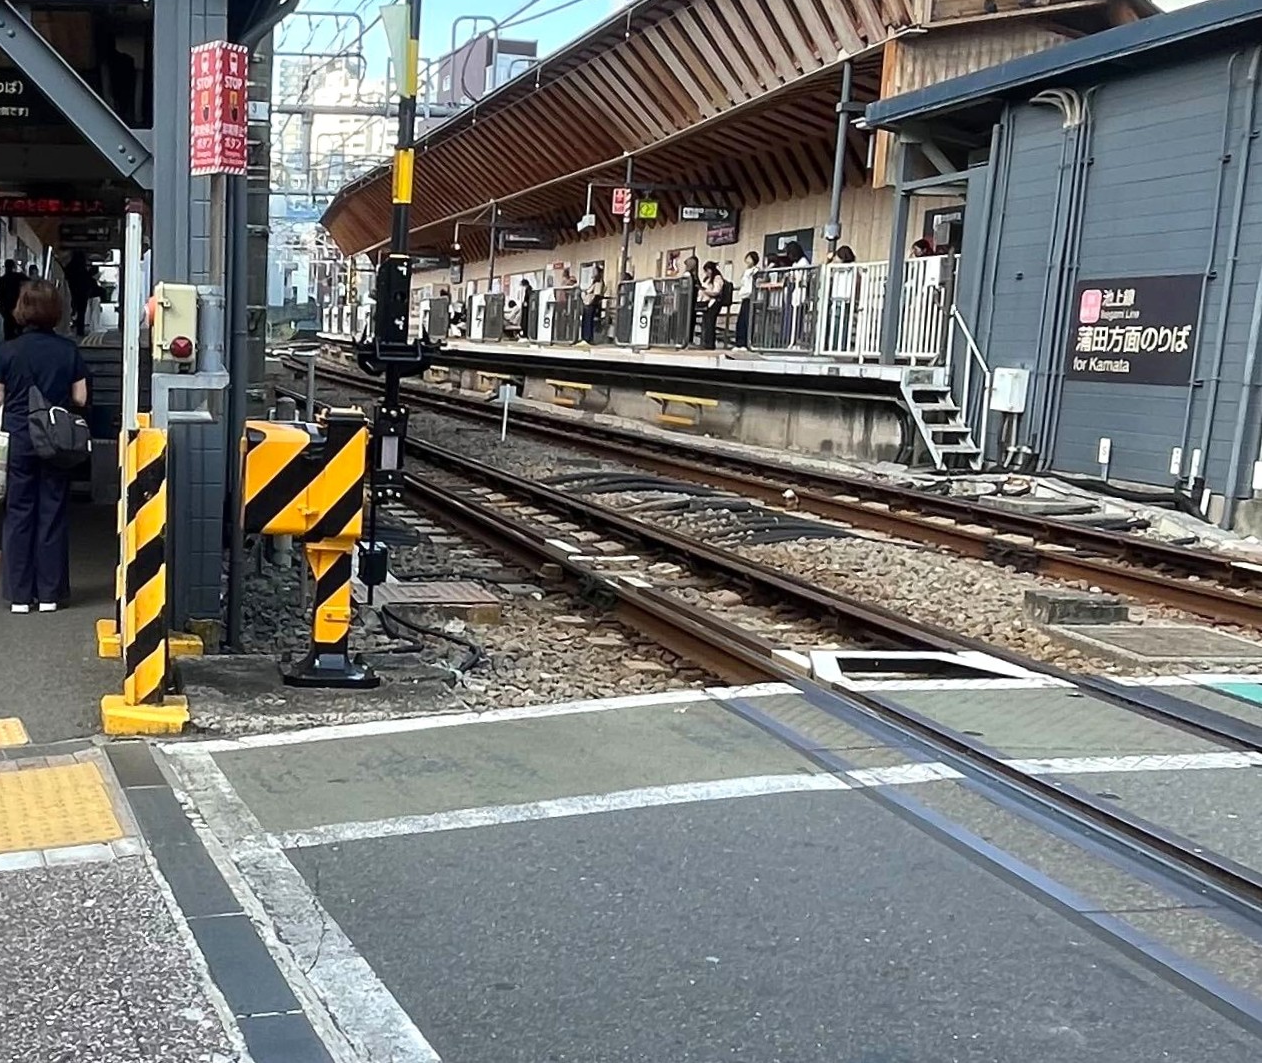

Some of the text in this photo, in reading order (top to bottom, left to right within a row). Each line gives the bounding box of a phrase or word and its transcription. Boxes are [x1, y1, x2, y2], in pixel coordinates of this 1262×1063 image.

[224, 75, 243, 90] STOP
[543, 316, 551, 329] 8
[638, 315, 648, 329] 9
[1075, 324, 1192, 353] 蒲田方面のりば
[1073, 356, 1130, 373] for Kamata
